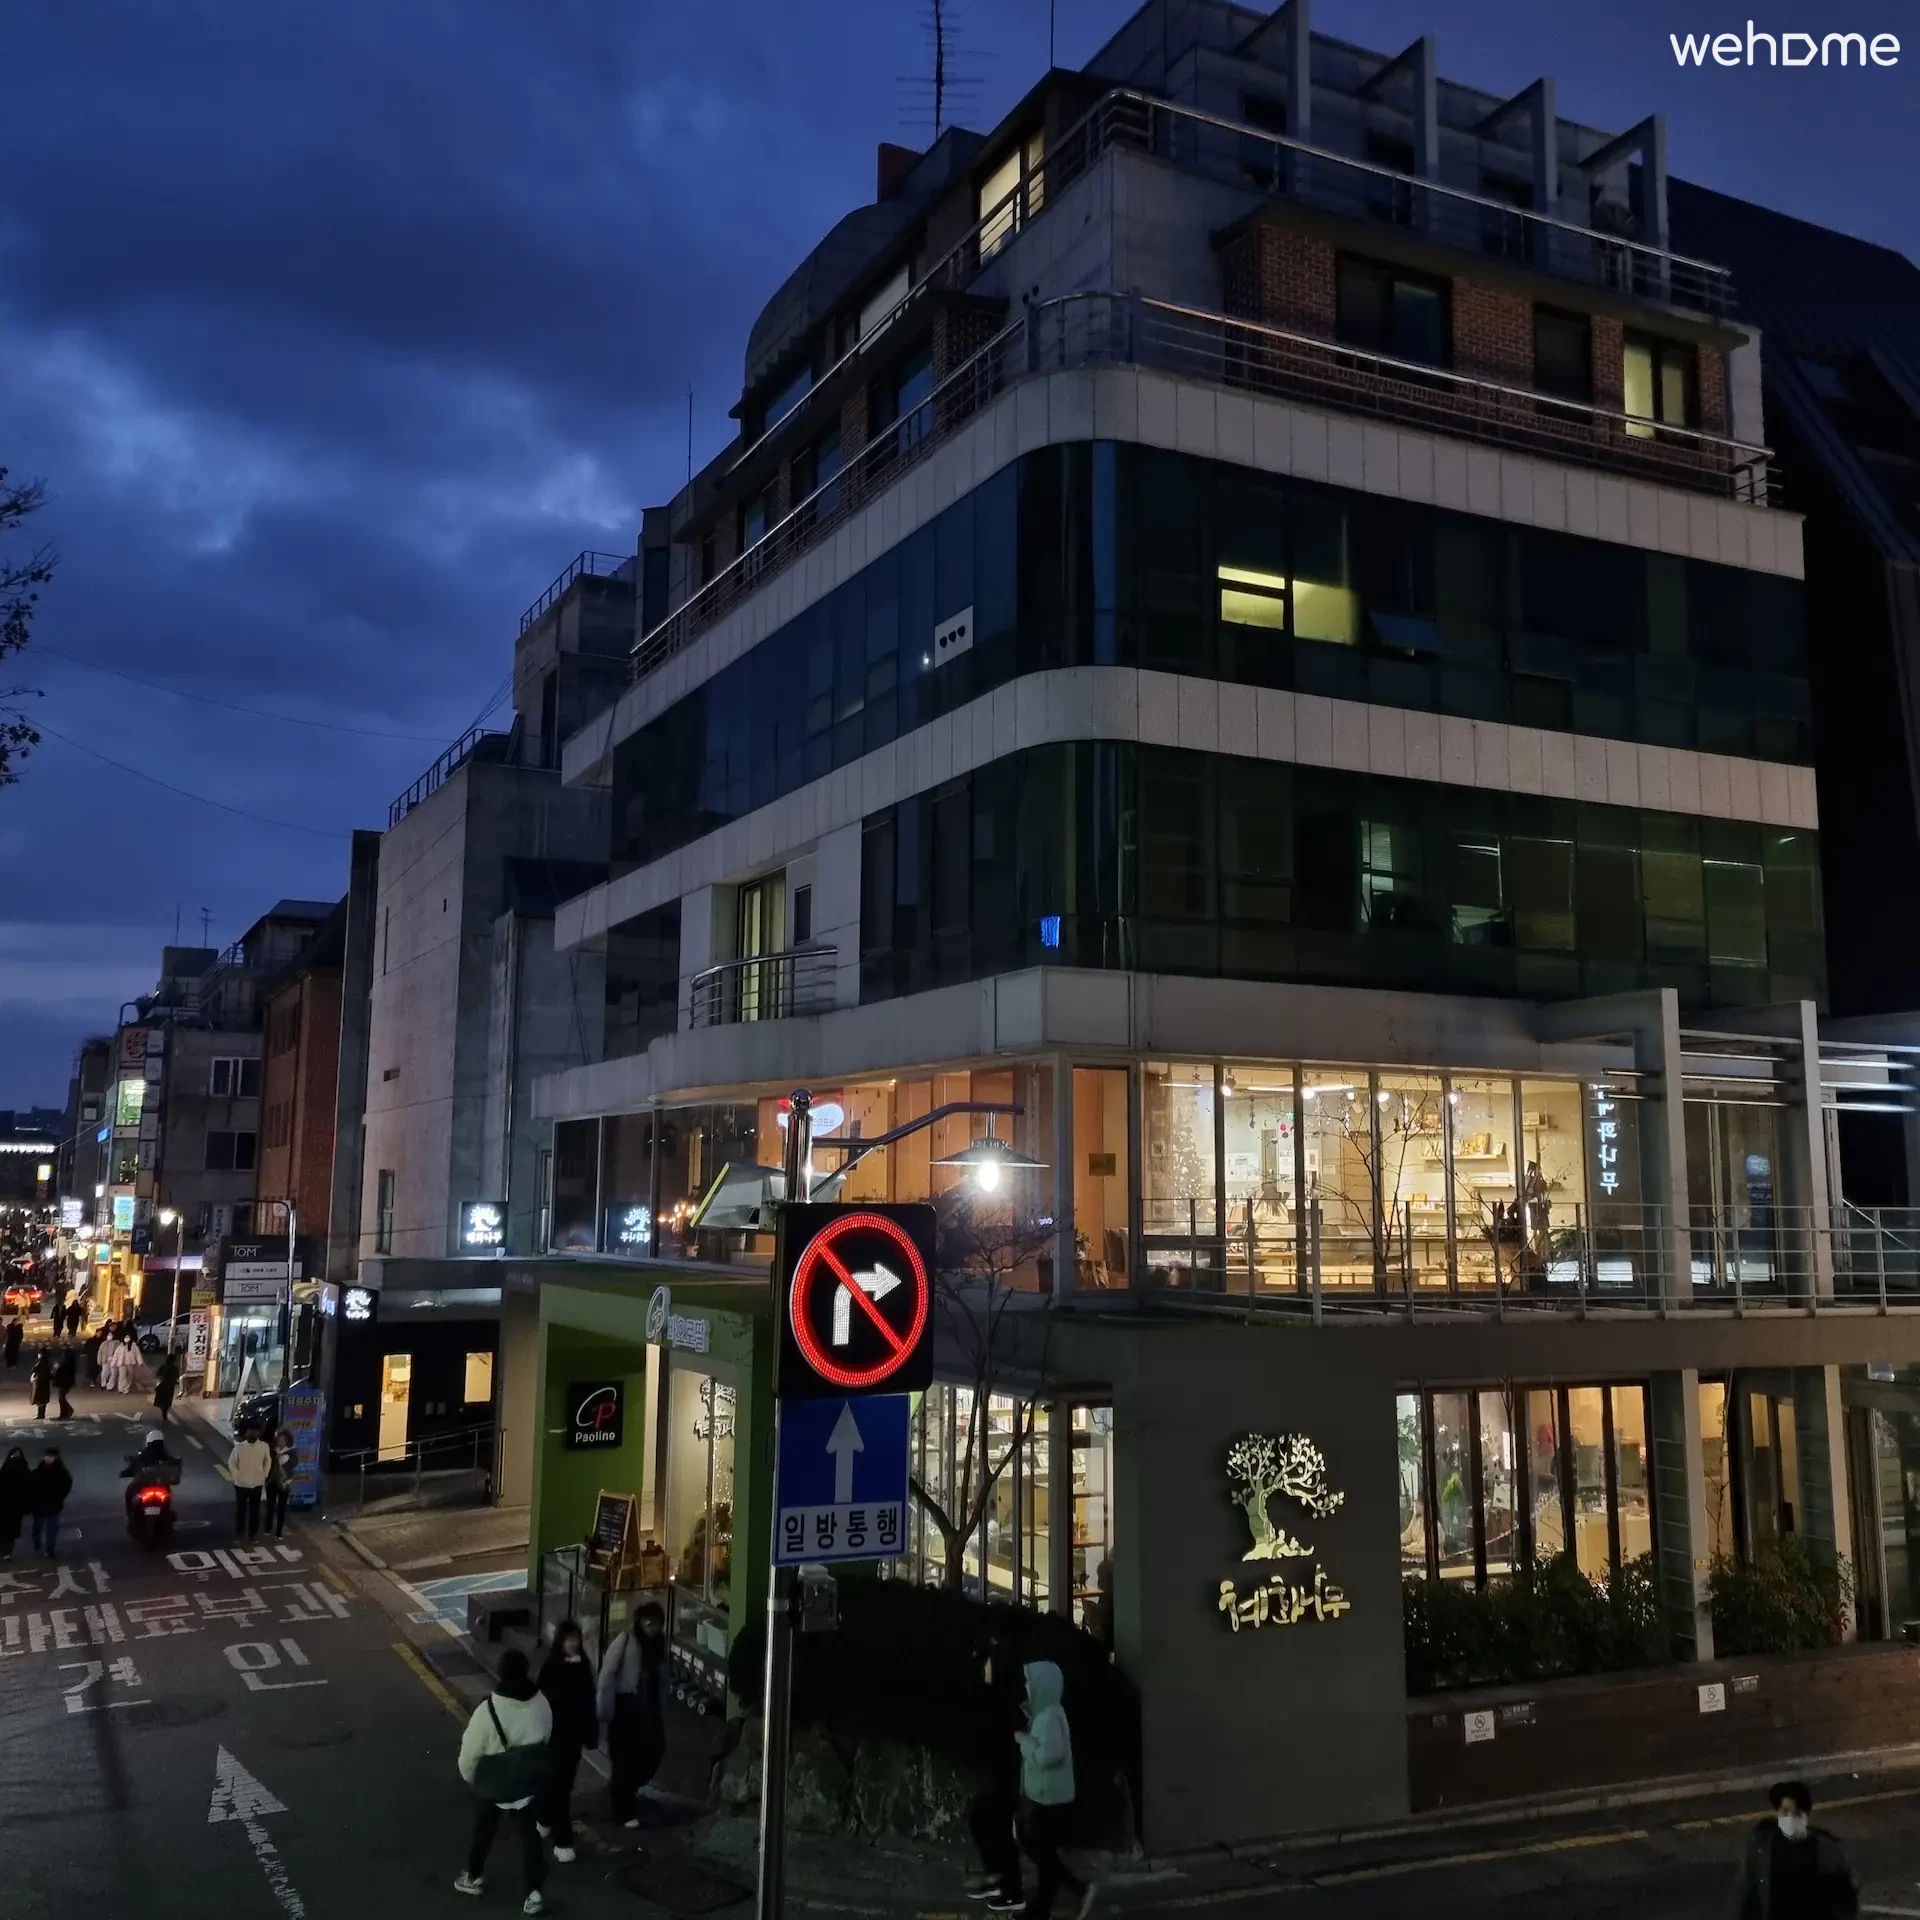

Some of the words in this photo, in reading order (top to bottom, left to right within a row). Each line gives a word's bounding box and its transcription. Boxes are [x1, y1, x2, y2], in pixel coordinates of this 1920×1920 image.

[229, 1244, 262, 1257] TOM
[238, 1282, 263, 1293] TOM
[194, 1323, 208, 1356] 주차장
[667, 1314, 707, 1353] 바오로딸
[575, 1431, 616, 1444] Paoline
[785, 1507, 897, 1553] 일방통행
[165, 1545, 308, 1581] 위반
[1218, 1563, 1351, 1633] 혜화나무
